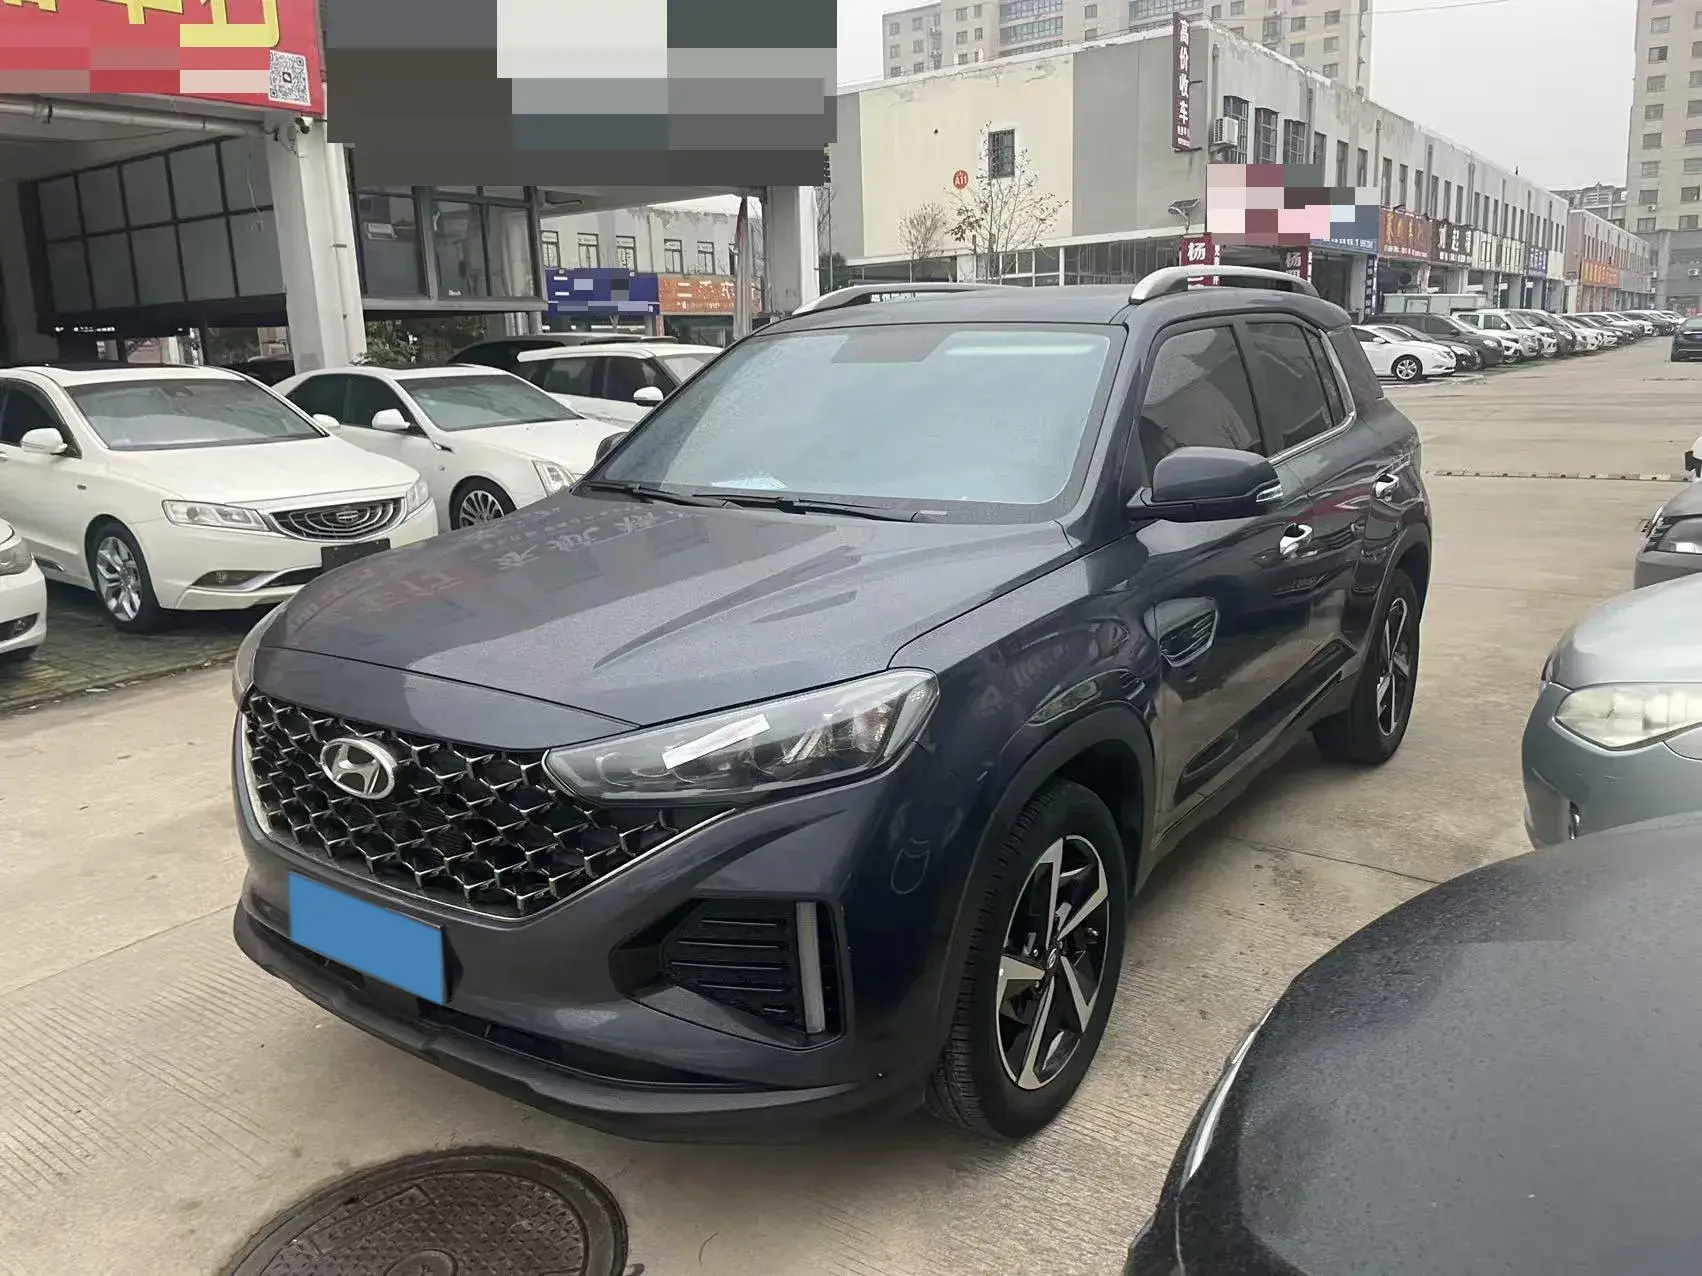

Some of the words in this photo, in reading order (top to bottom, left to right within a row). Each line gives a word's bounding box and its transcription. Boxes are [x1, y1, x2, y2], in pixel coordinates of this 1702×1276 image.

[1178, 19, 1189, 124] 高价收车
[954, 175, 967, 186] A11
